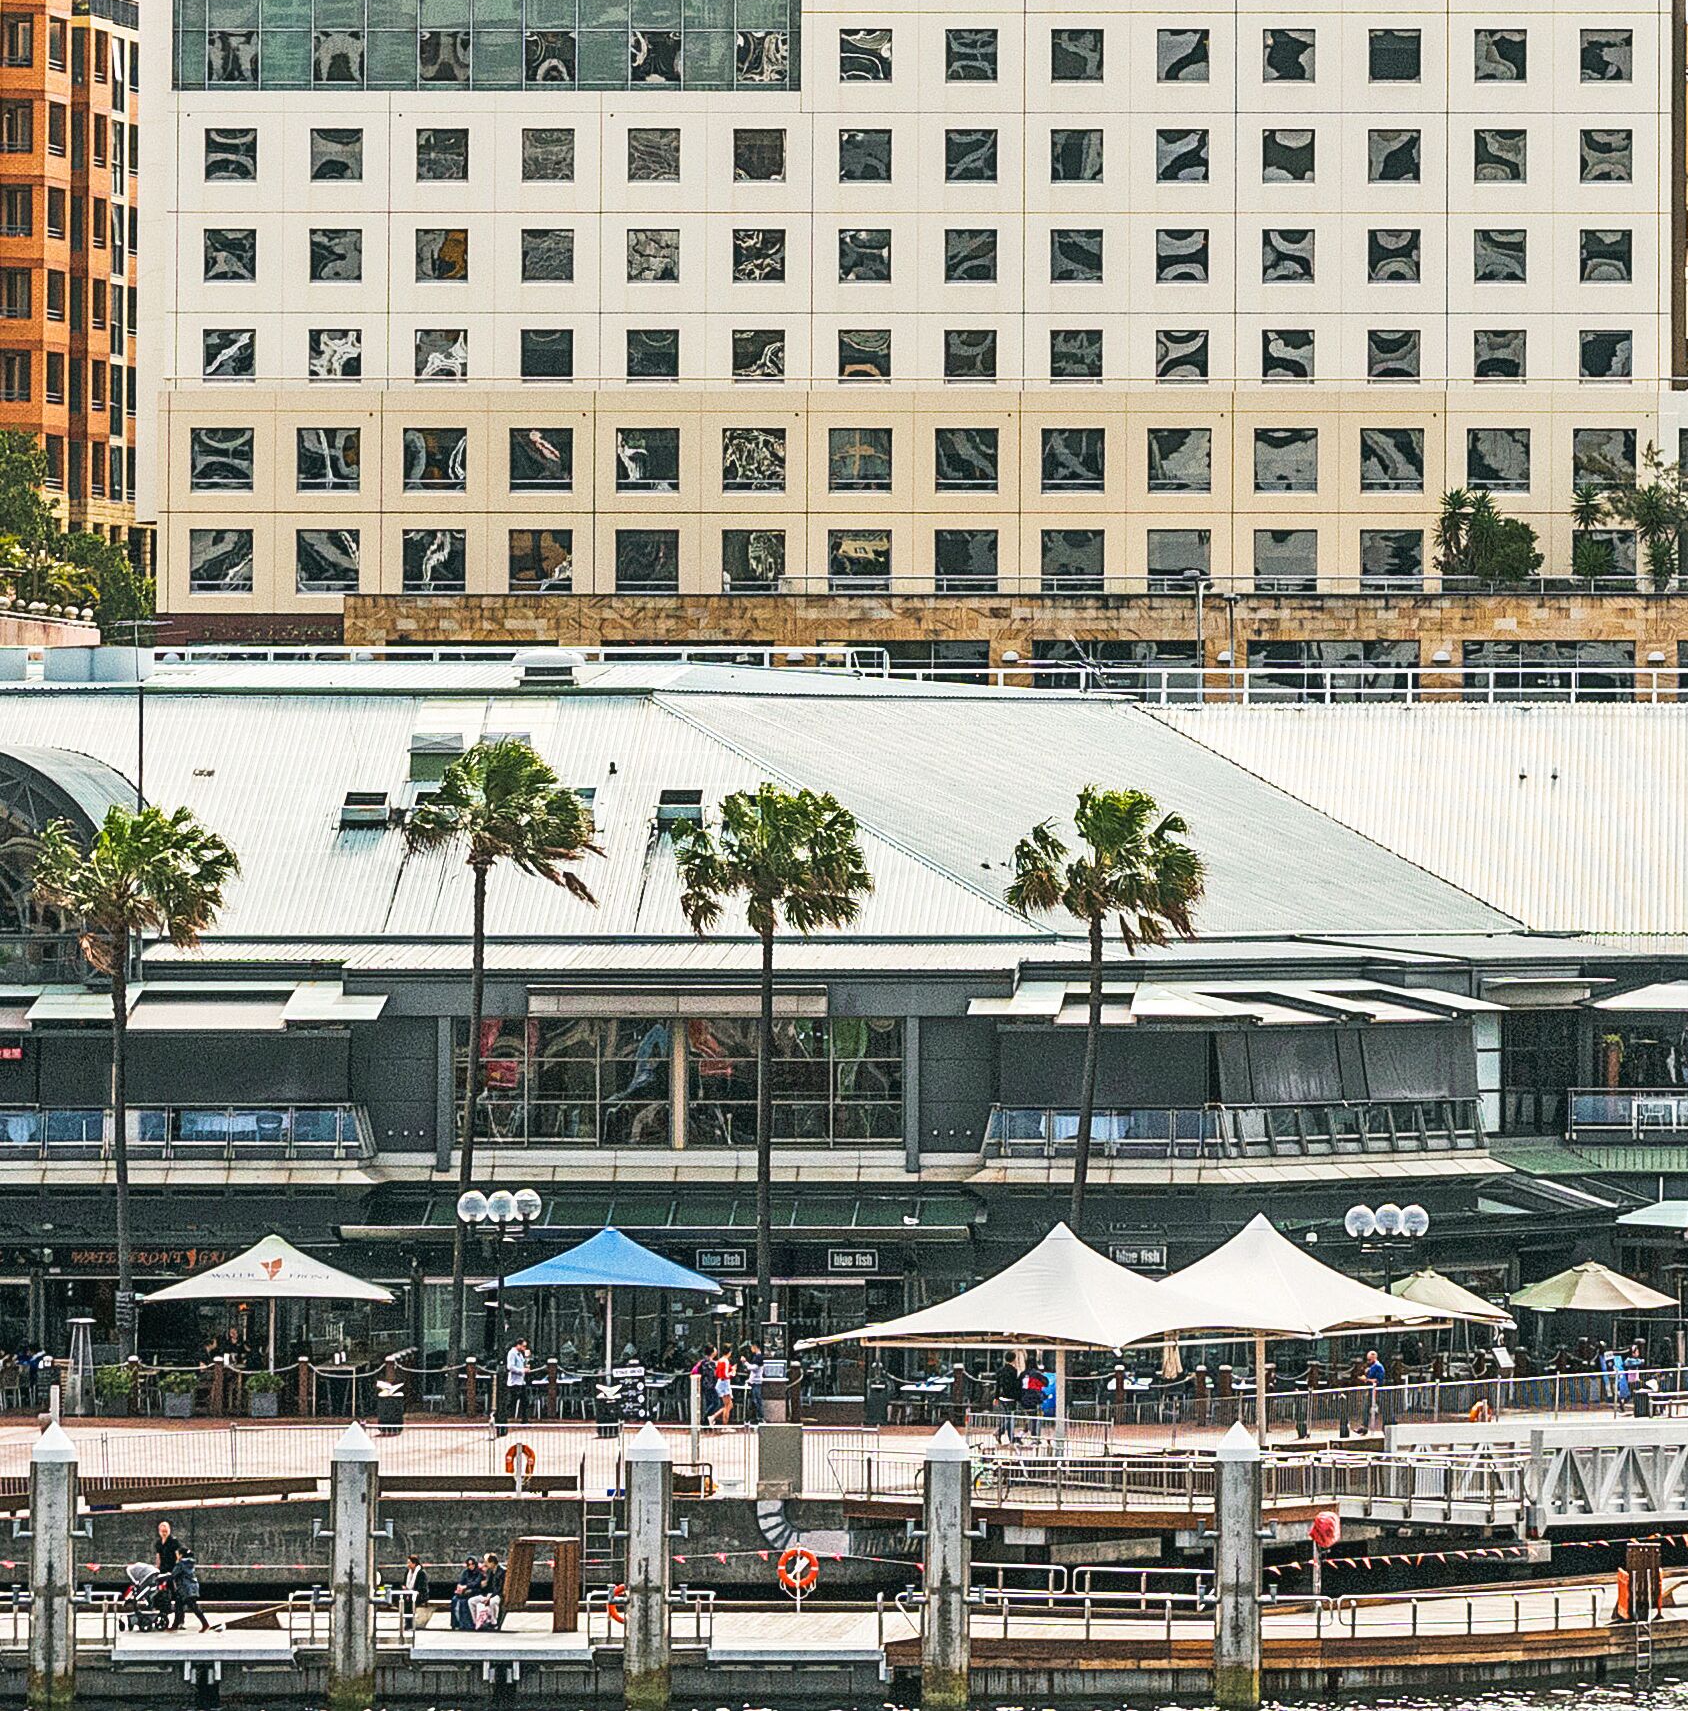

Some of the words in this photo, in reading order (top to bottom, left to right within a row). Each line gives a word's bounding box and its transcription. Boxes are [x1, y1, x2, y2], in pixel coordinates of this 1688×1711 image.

[702, 1253, 721, 1266] blue
[724, 1253, 741, 1266] fish
[834, 1253, 852, 1266] blue
[856, 1253, 873, 1266] fish
[1116, 1249, 1138, 1264] blue
[1141, 1249, 1160, 1264] fish
